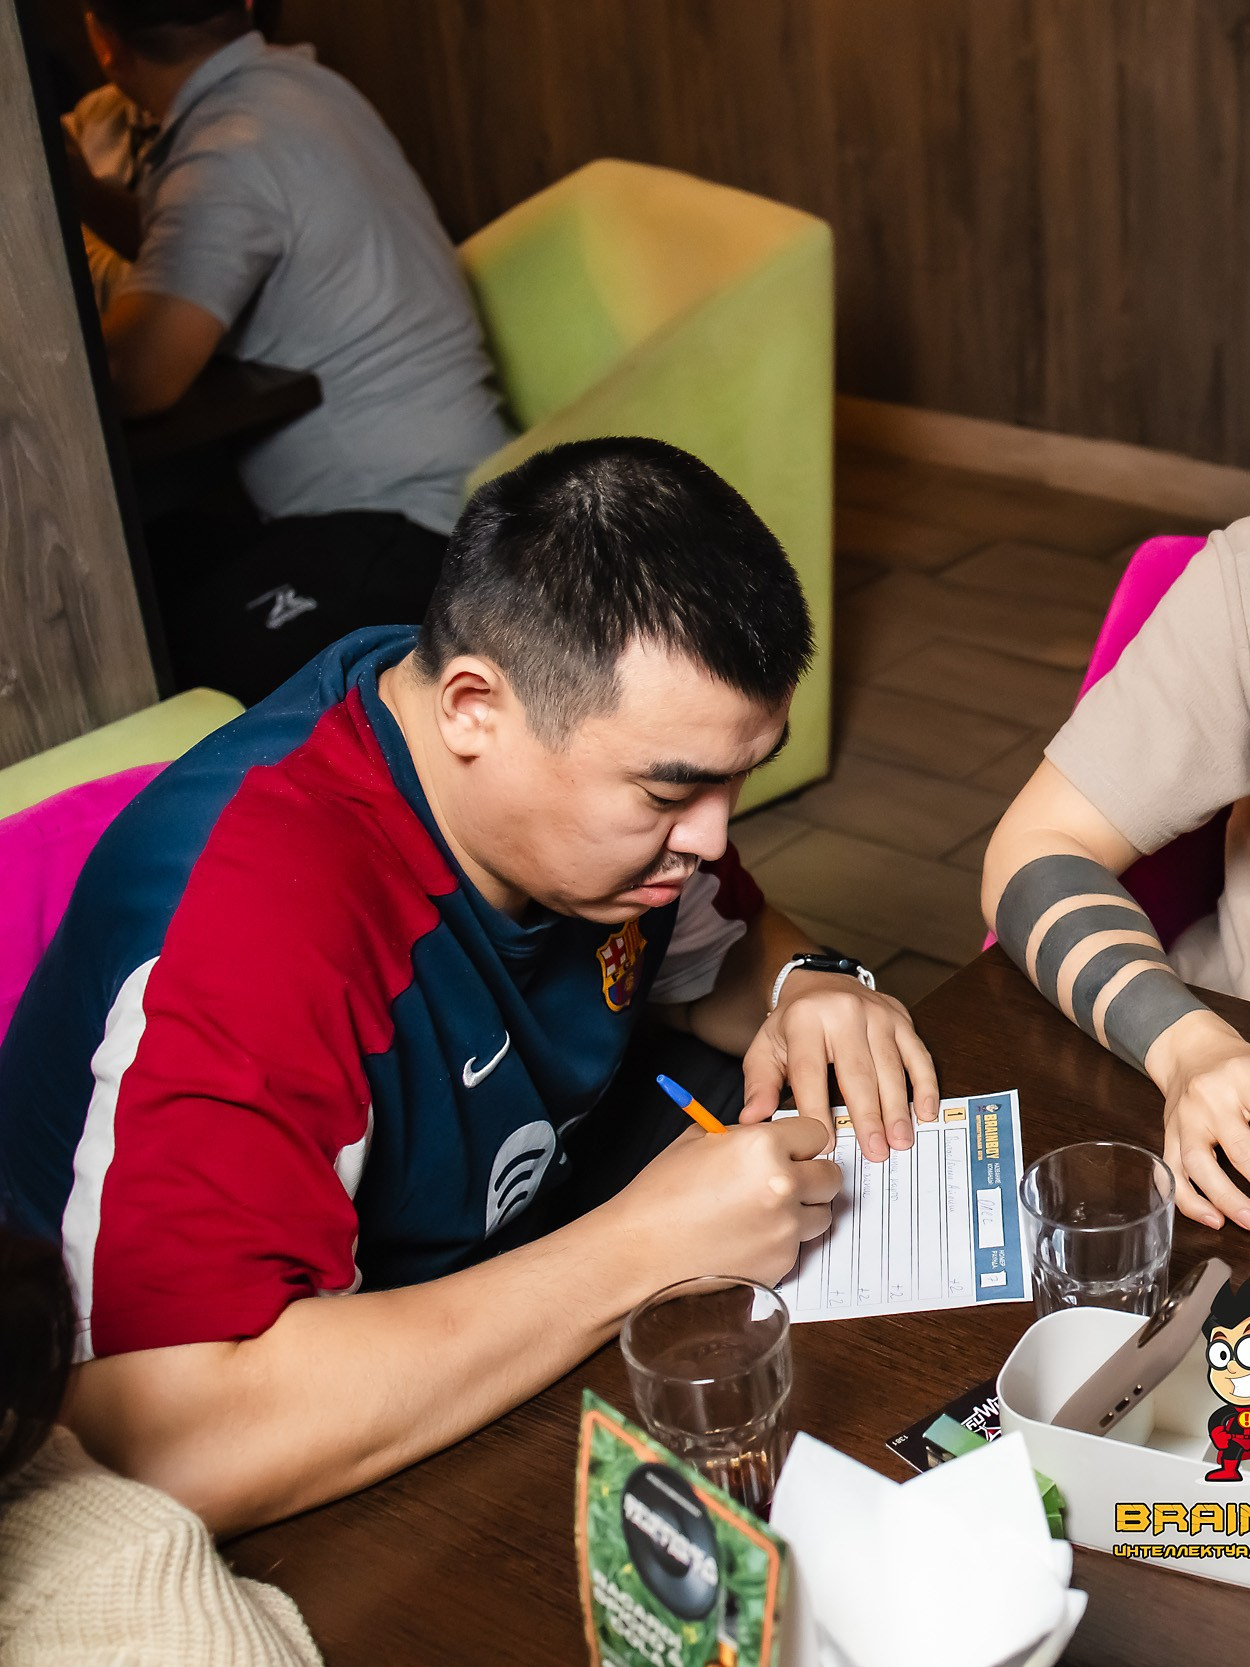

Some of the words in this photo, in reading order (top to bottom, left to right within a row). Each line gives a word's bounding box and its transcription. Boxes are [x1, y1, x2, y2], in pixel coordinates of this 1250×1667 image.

[984, 1113, 1000, 1159] BRAINBOY
[994, 1162, 1002, 1184] НАЗВАНИЕ
[889, 1284, 904, 1300] +2
[949, 1278, 964, 1294] +2
[829, 1289, 844, 1306] +2
[858, 1287, 870, 1302] +2
